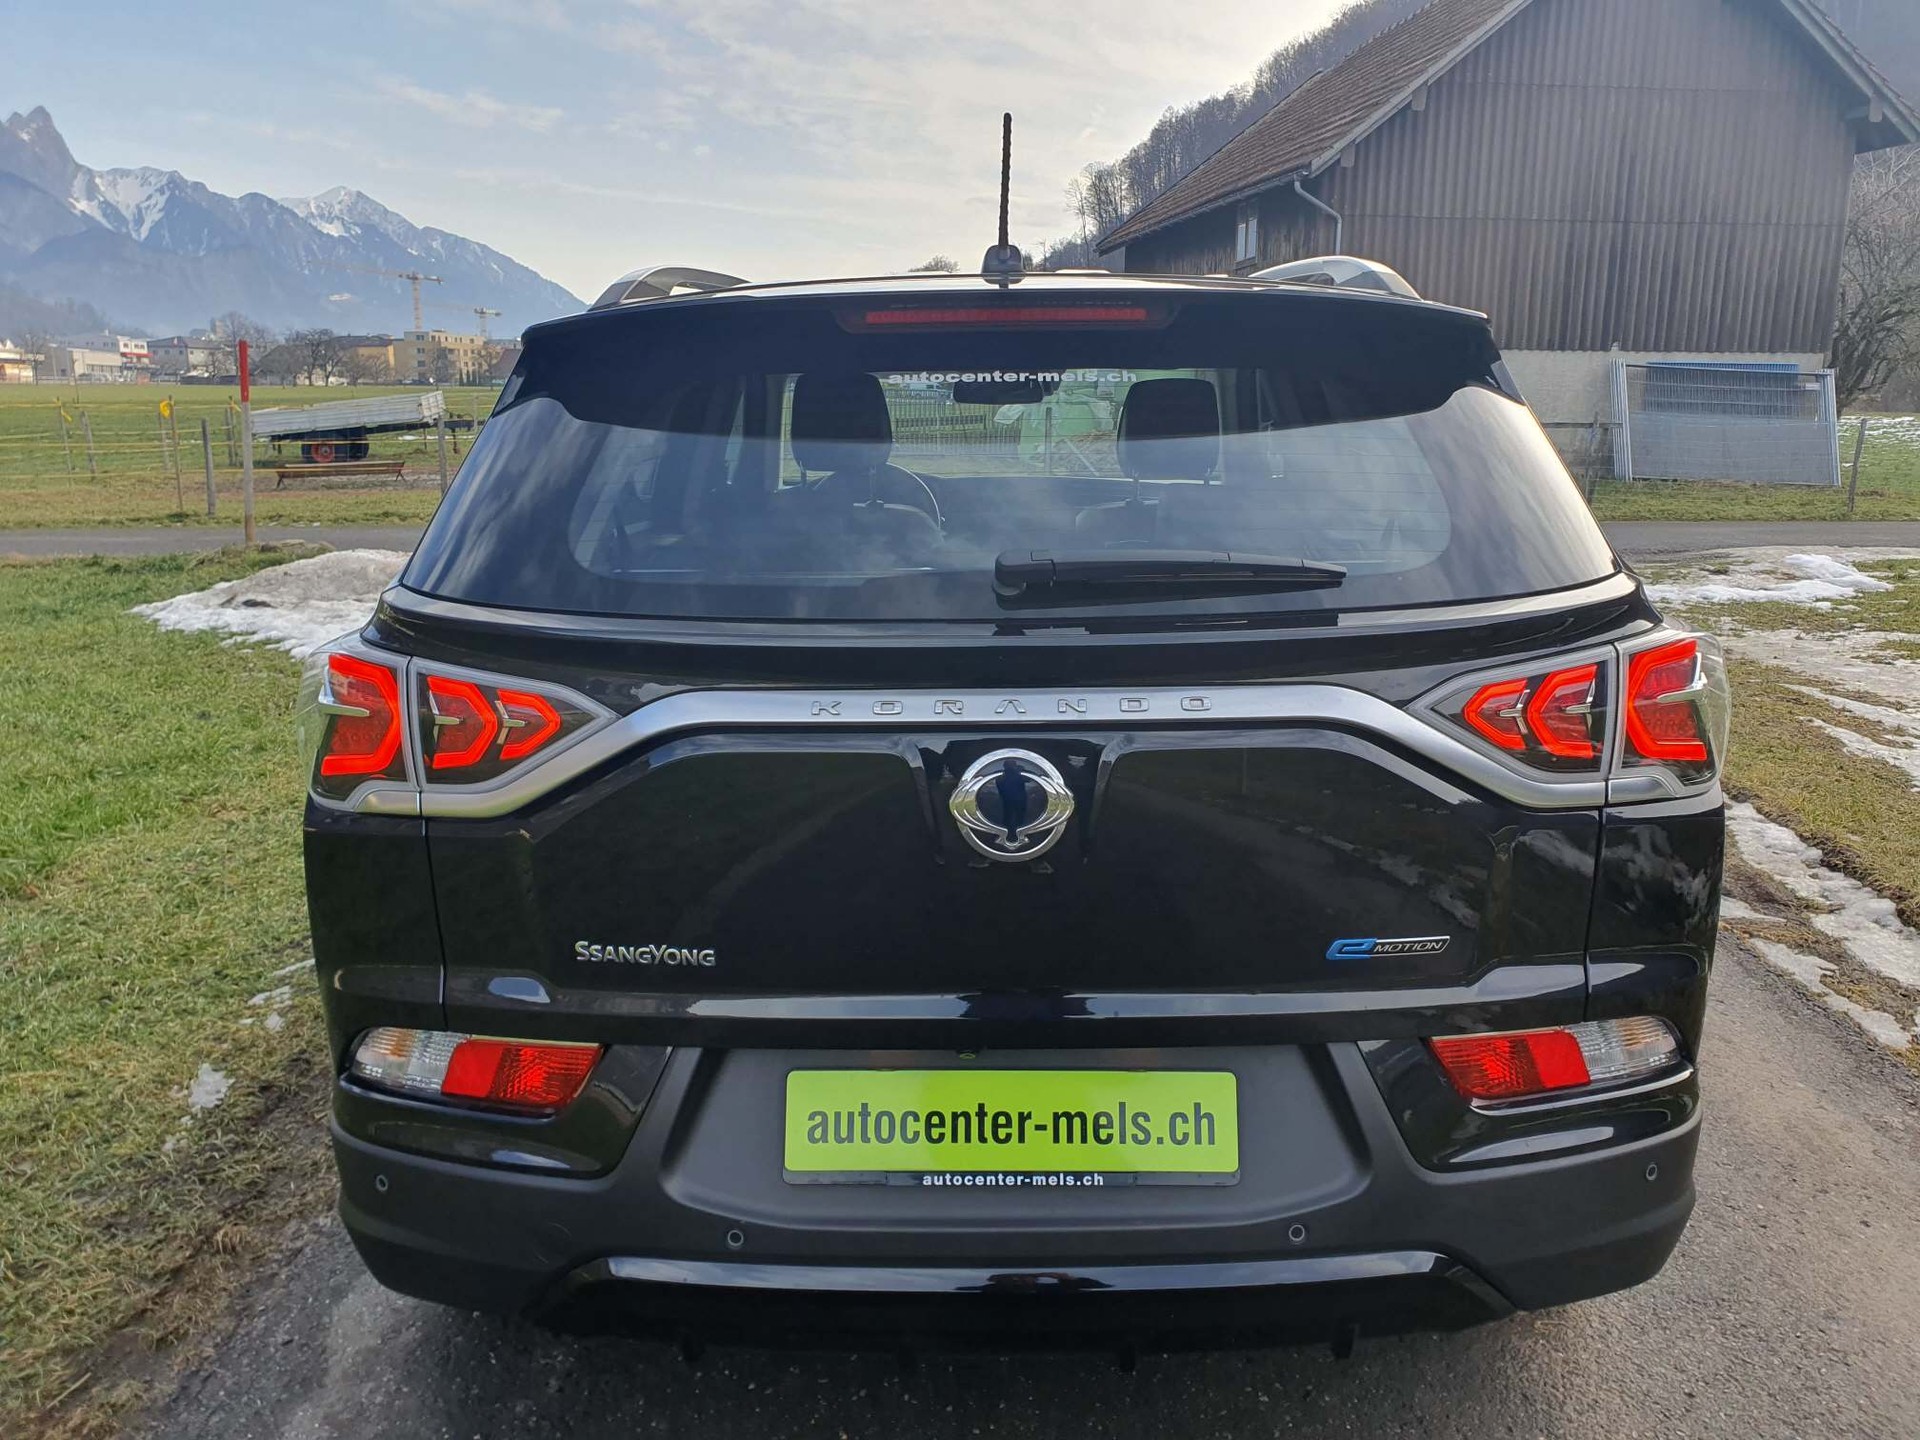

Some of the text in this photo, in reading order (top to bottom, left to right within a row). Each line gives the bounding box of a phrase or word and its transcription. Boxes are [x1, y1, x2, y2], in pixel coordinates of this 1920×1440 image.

[811, 695, 1213, 716] KORANDO
[807, 1102, 1216, 1145] autocenter-mels.ch
[922, 1172, 1104, 1187] autocenter-mels.ch
